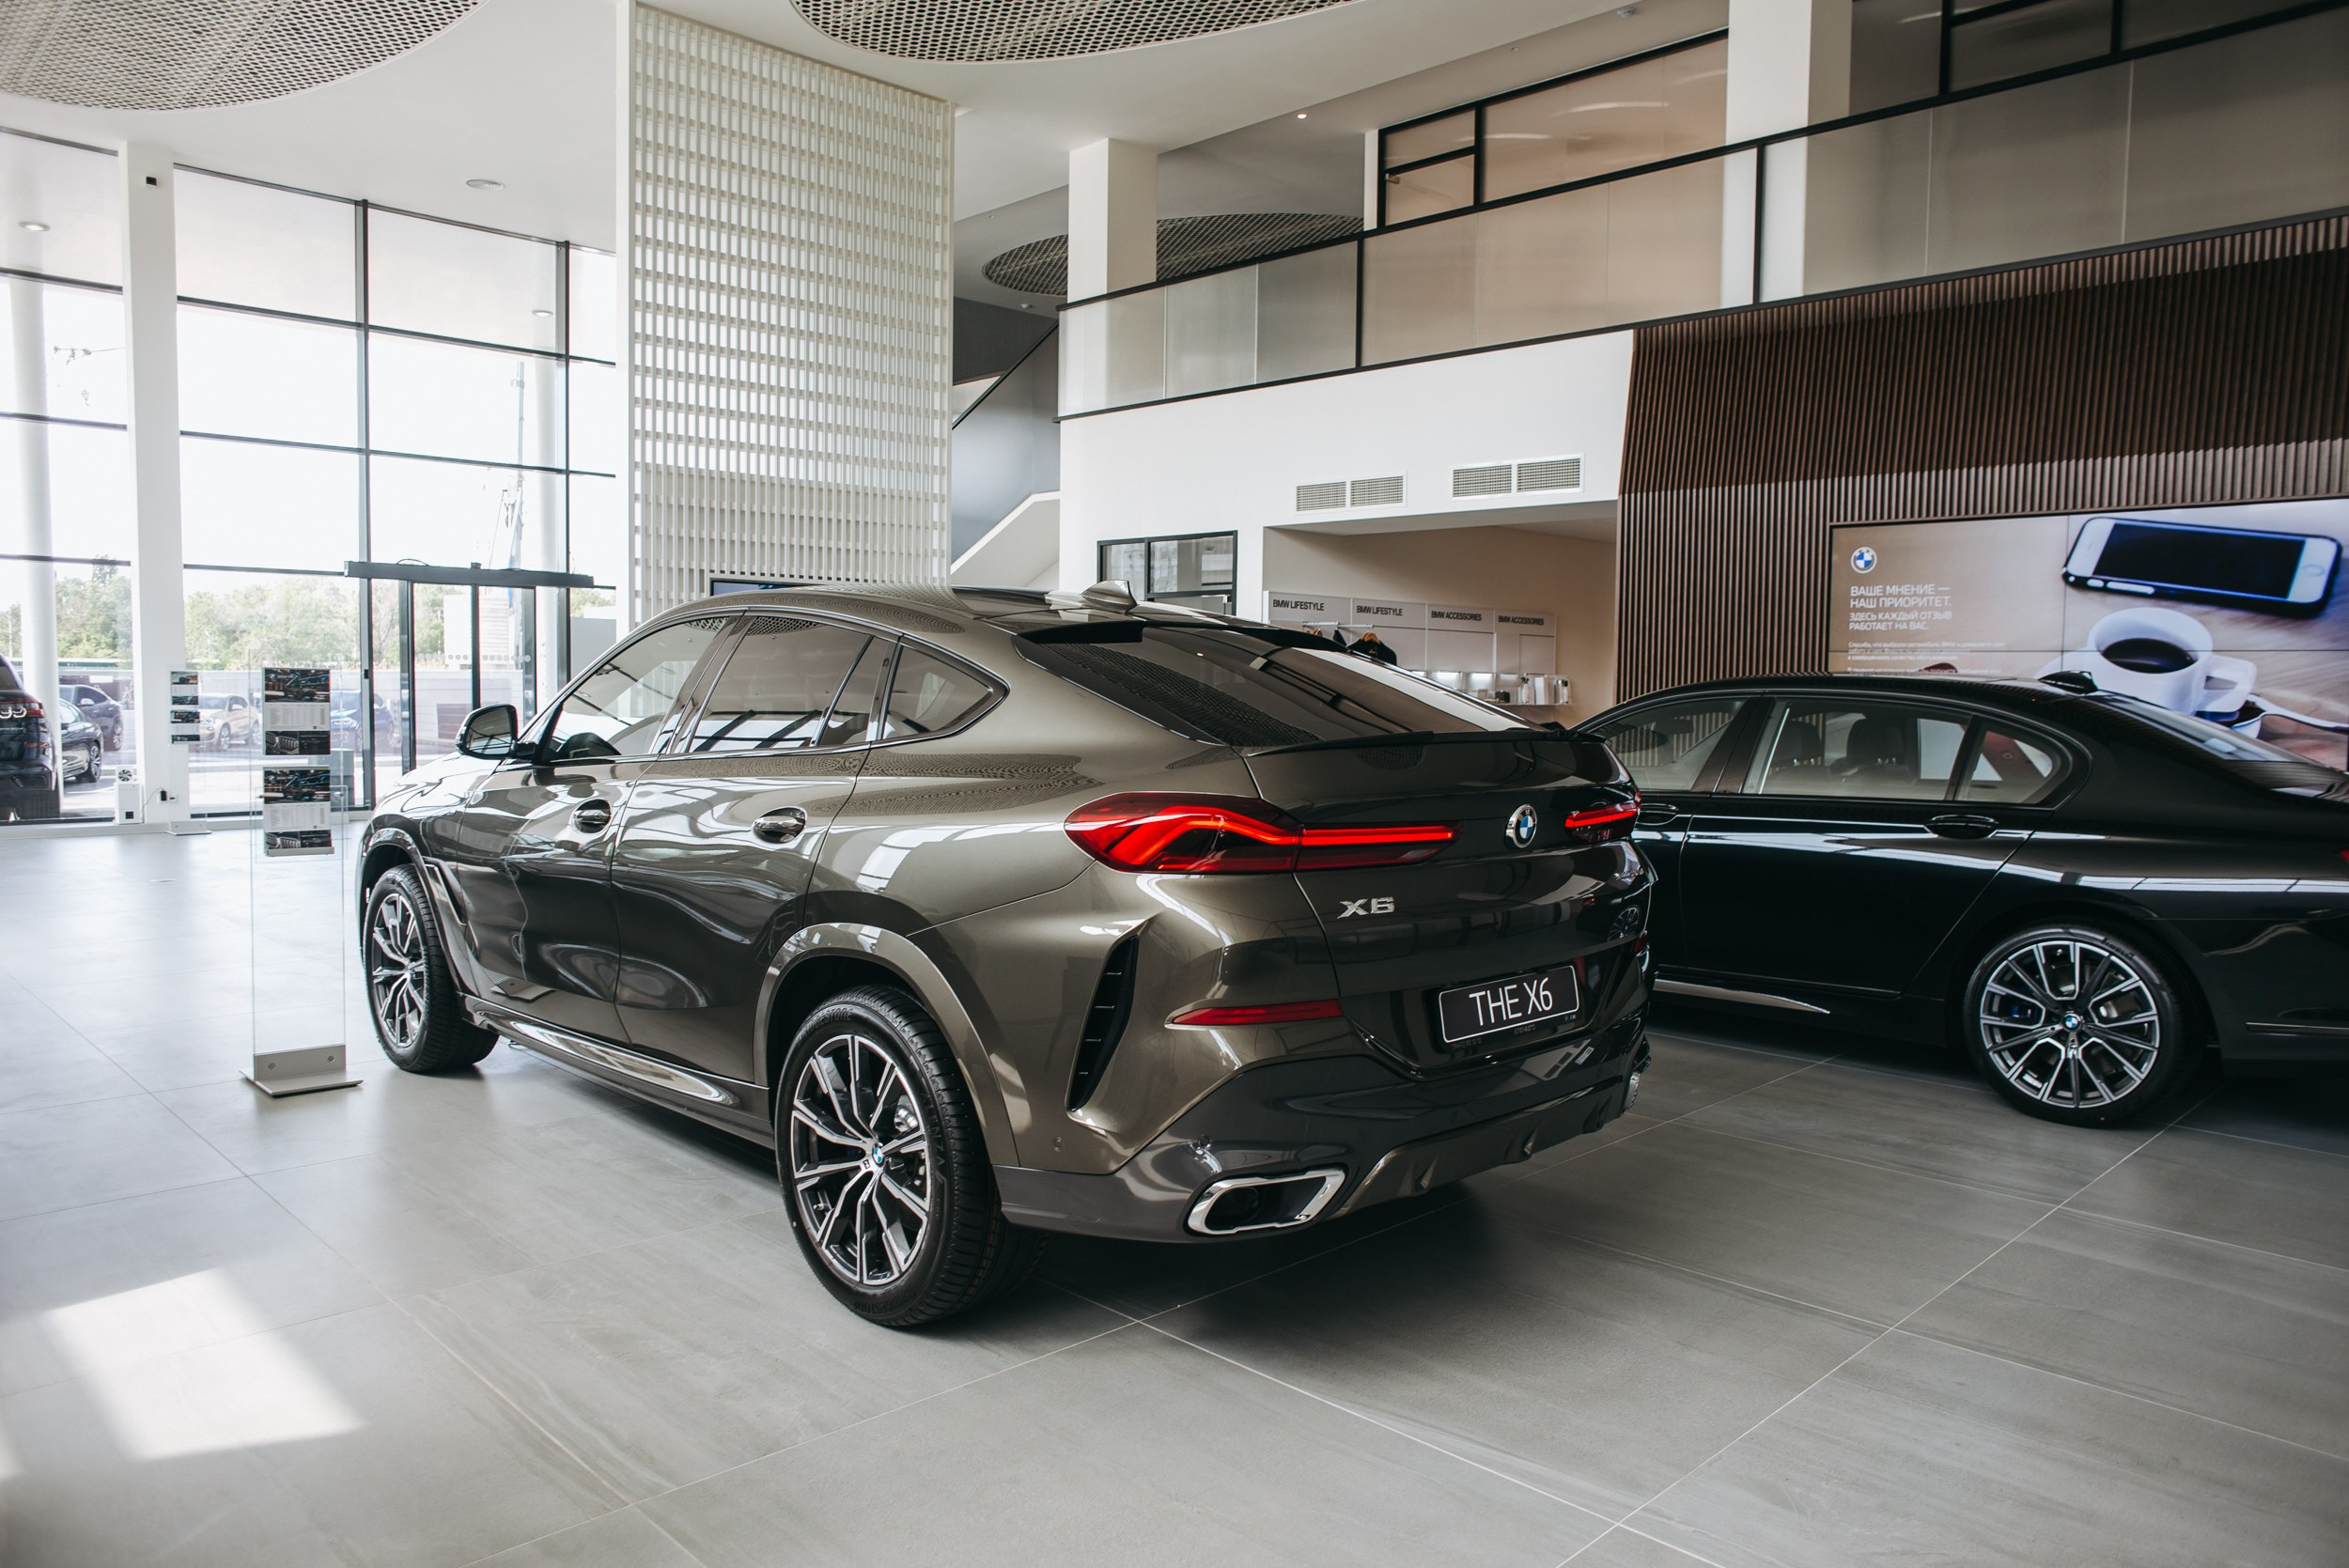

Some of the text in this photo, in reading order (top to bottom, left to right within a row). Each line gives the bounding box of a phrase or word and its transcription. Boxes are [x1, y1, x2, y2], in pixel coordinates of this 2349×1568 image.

[1850, 585, 1884, 597] ВАШЕ
[1885, 583, 1936, 595] МНЕНИЕ
[1272, 599, 1324, 611] BMW LIFESTYLE
[1849, 596, 1952, 608] НАШ ПРИОРИТЕТ.
[1357, 605, 1403, 616] BMW LIFESTYLE
[1431, 611, 1483, 622] BMW ACCESSORIES
[1849, 610, 1952, 621] ЗДЕСЬ КАЖДЫЙ ОТЗЫВ
[1849, 622, 1893, 631] РАБОТАЕТ
[1894, 622, 1908, 630] НА
[1337, 896, 1395, 919] X6
[1469, 977, 1553, 1026] THE X6
